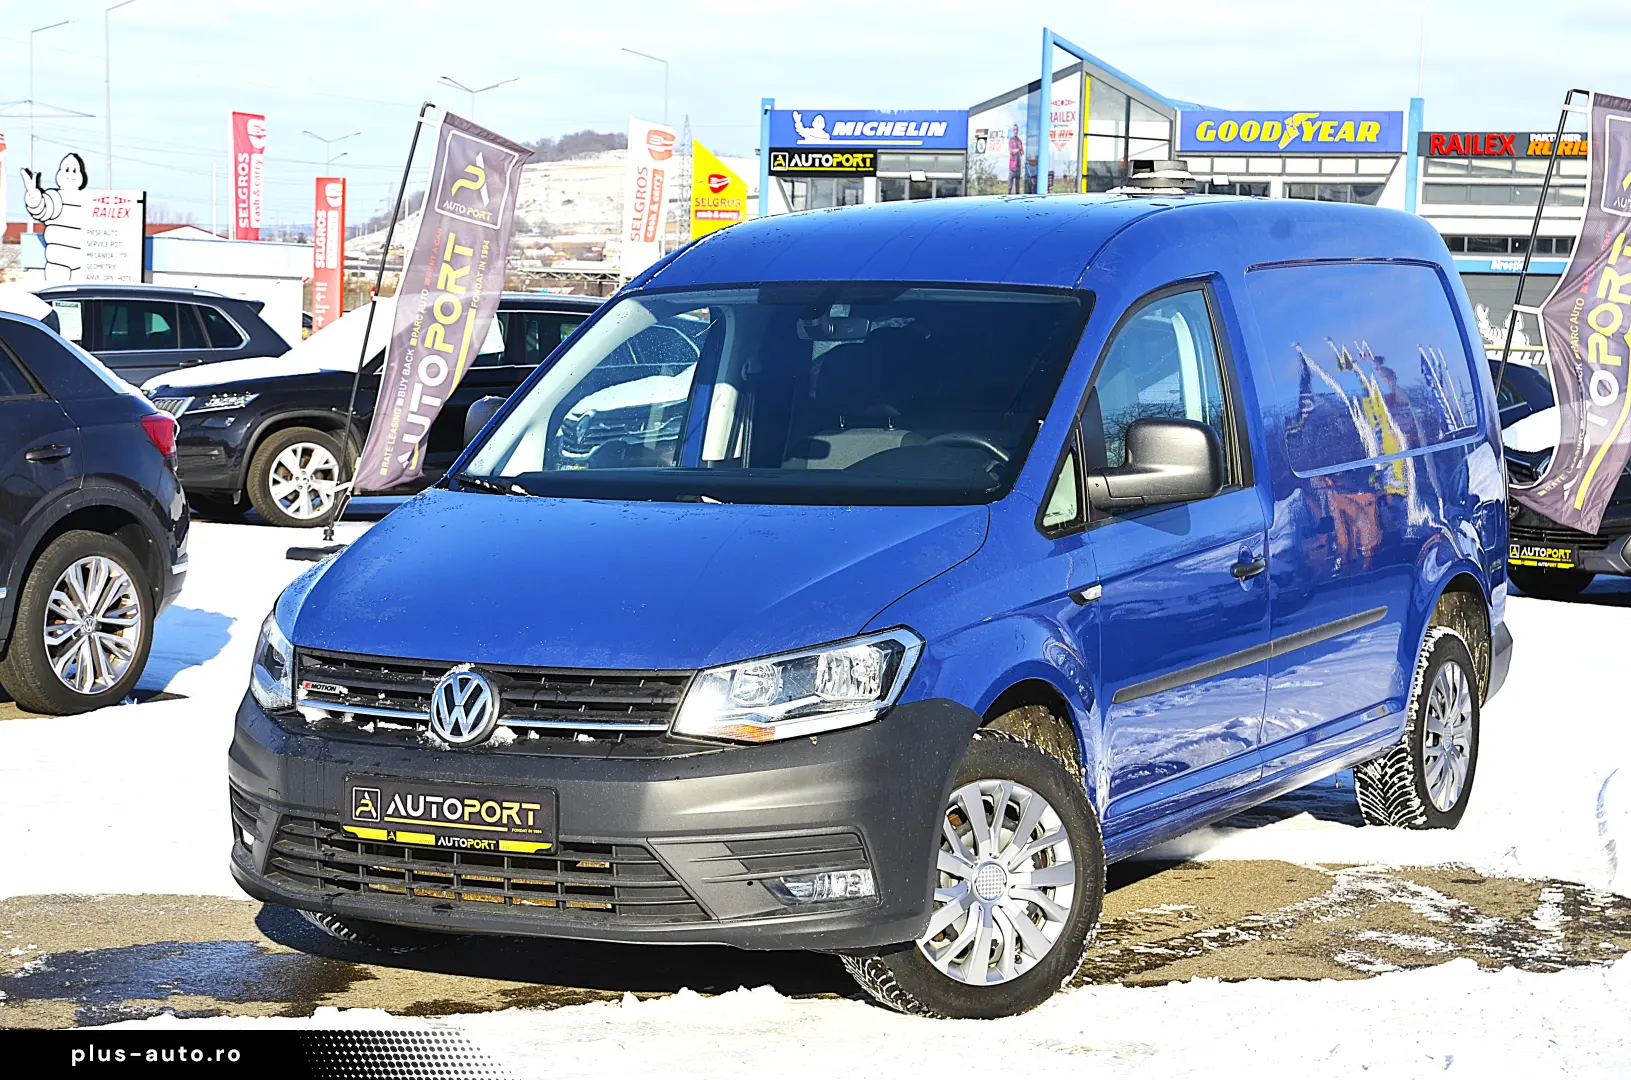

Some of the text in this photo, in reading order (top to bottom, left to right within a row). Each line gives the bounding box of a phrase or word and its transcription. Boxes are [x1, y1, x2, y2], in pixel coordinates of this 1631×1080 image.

[832, 121, 948, 137] MICHELIN
[1430, 133, 1517, 156] RAILEX
[790, 153, 874, 168] AUTOPORT
[237, 152, 249, 228] SELGROS
[92, 207, 131, 219] RAILEX
[443, 200, 492, 224] AUTO PORT
[630, 166, 648, 242] SELGROS
[695, 198, 741, 208] SELGROS
[315, 209, 327, 269] SELGROS
[480, 240, 490, 259] 1994
[418, 289, 429, 314] AUTO
[1572, 298, 1585, 323] AUTO
[411, 313, 423, 338] PARC
[403, 348, 416, 377] BACK
[398, 378, 409, 398] BUY
[388, 408, 402, 444] LEASING
[381, 444, 394, 469] RATE
[1521, 546, 1572, 559] AUTOPORT
[386, 792, 541, 826] AUTOPORT
[437, 835, 497, 850] AUTOPORT
